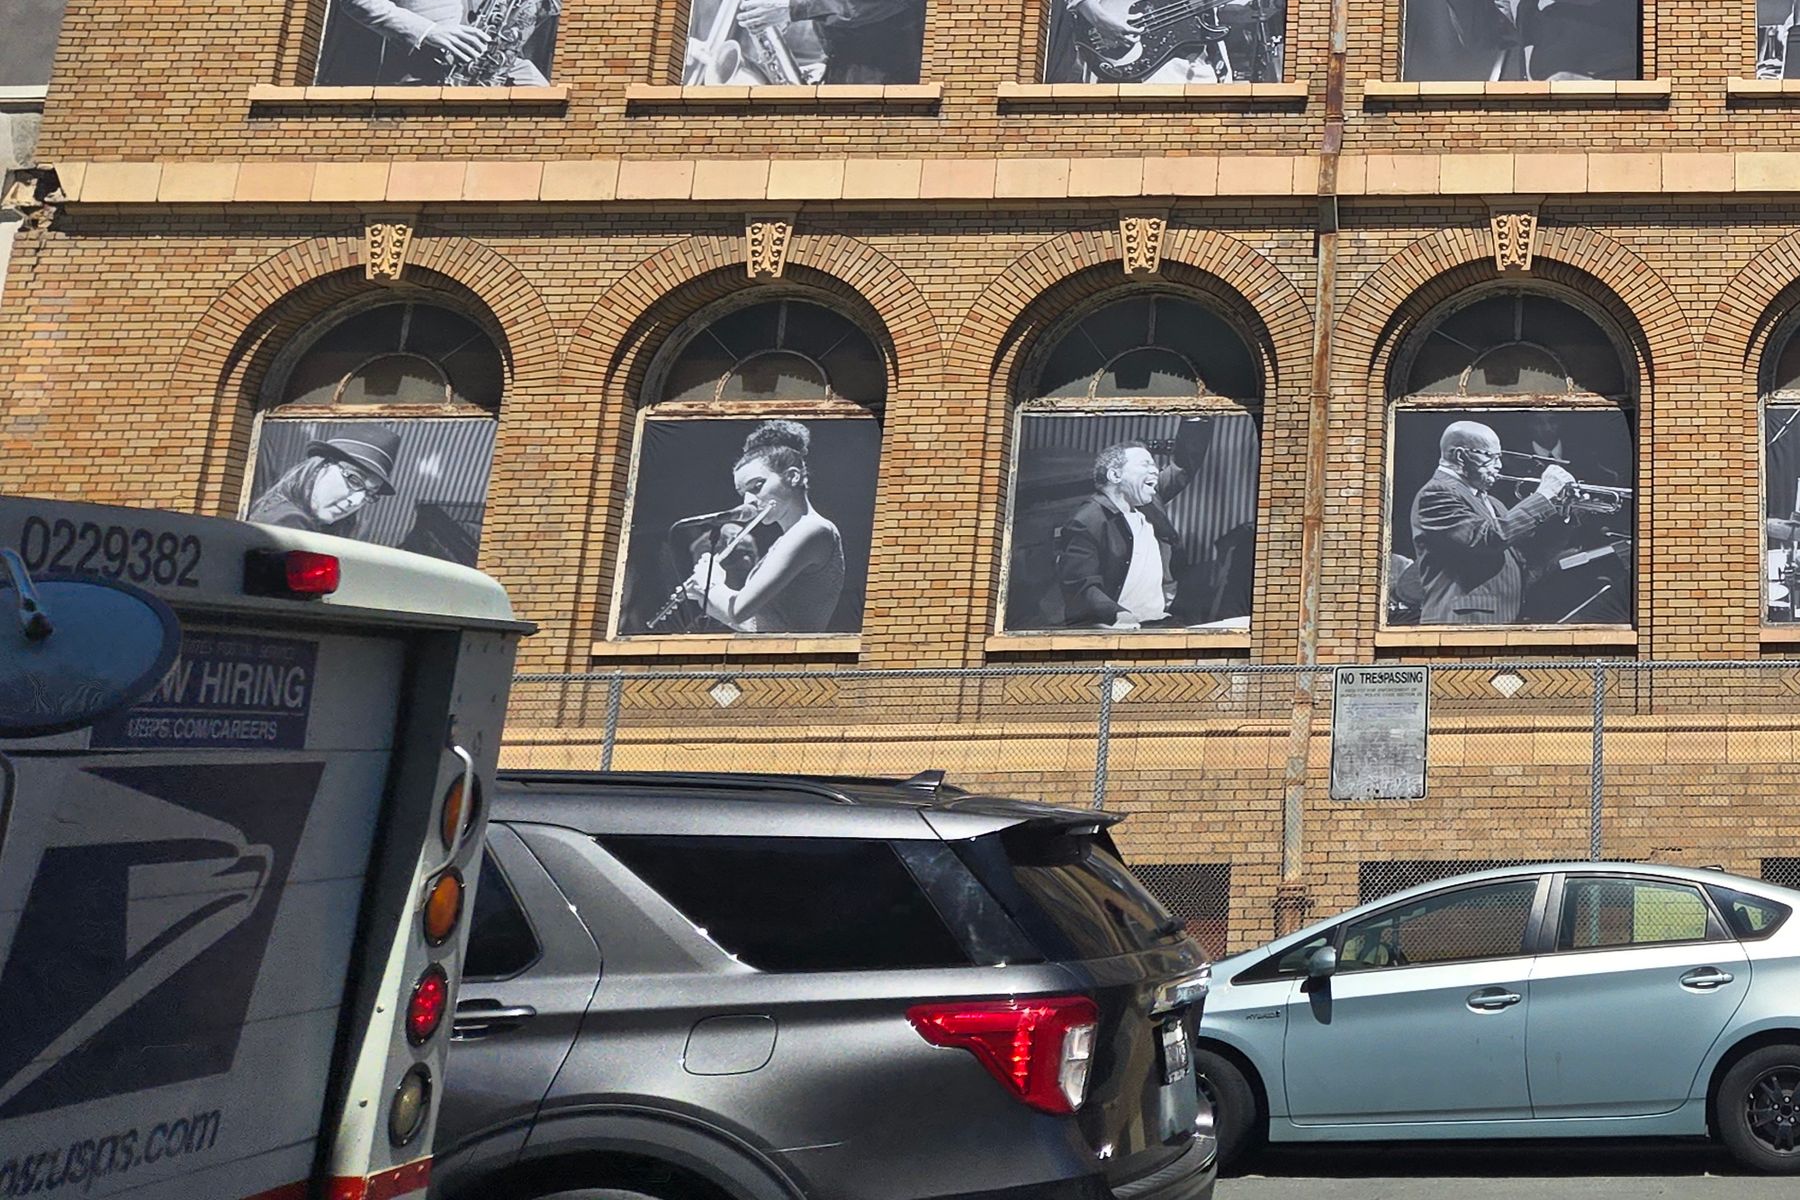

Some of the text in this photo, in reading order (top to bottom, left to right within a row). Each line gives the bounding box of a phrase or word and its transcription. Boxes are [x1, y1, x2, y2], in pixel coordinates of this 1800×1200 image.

[20, 515, 201, 587] 0229382
[200, 661, 306, 708] HIRING
[1340, 671, 1424, 685] NO TRESPASSING
